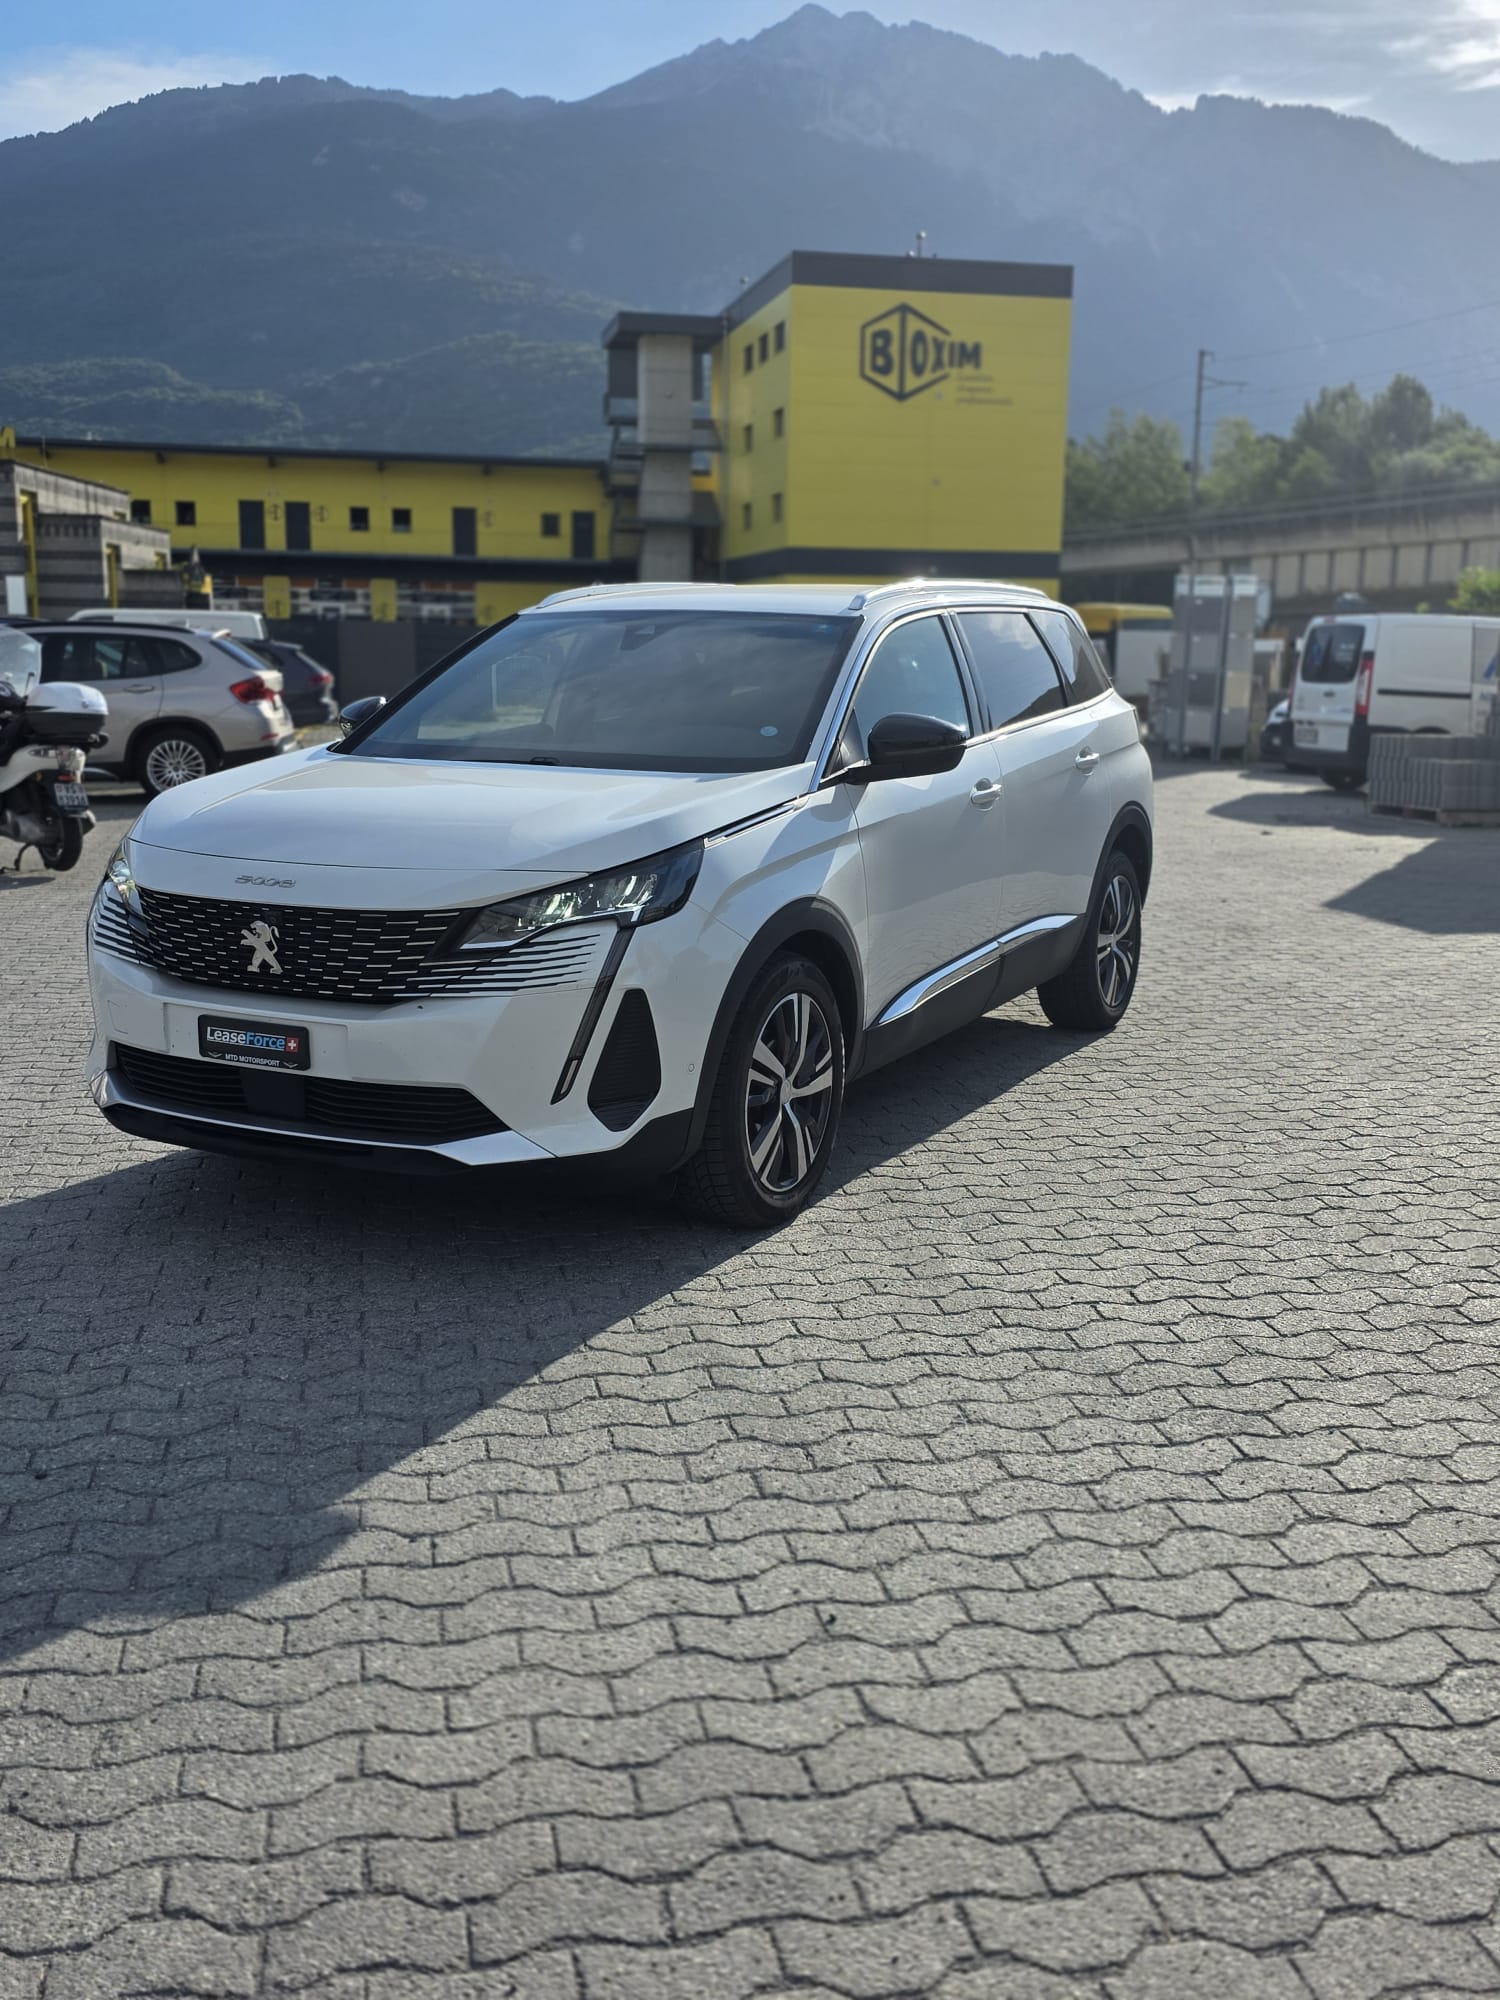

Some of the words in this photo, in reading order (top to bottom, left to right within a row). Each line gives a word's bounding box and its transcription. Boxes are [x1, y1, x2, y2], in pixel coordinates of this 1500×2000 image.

[871, 328, 982, 377] BOXIM
[235, 875, 296, 888] 5008
[206, 1026, 286, 1049] LeaseForce
[225, 1053, 238, 1061] MTD
[239, 1055, 280, 1067] MOTORSPORT
